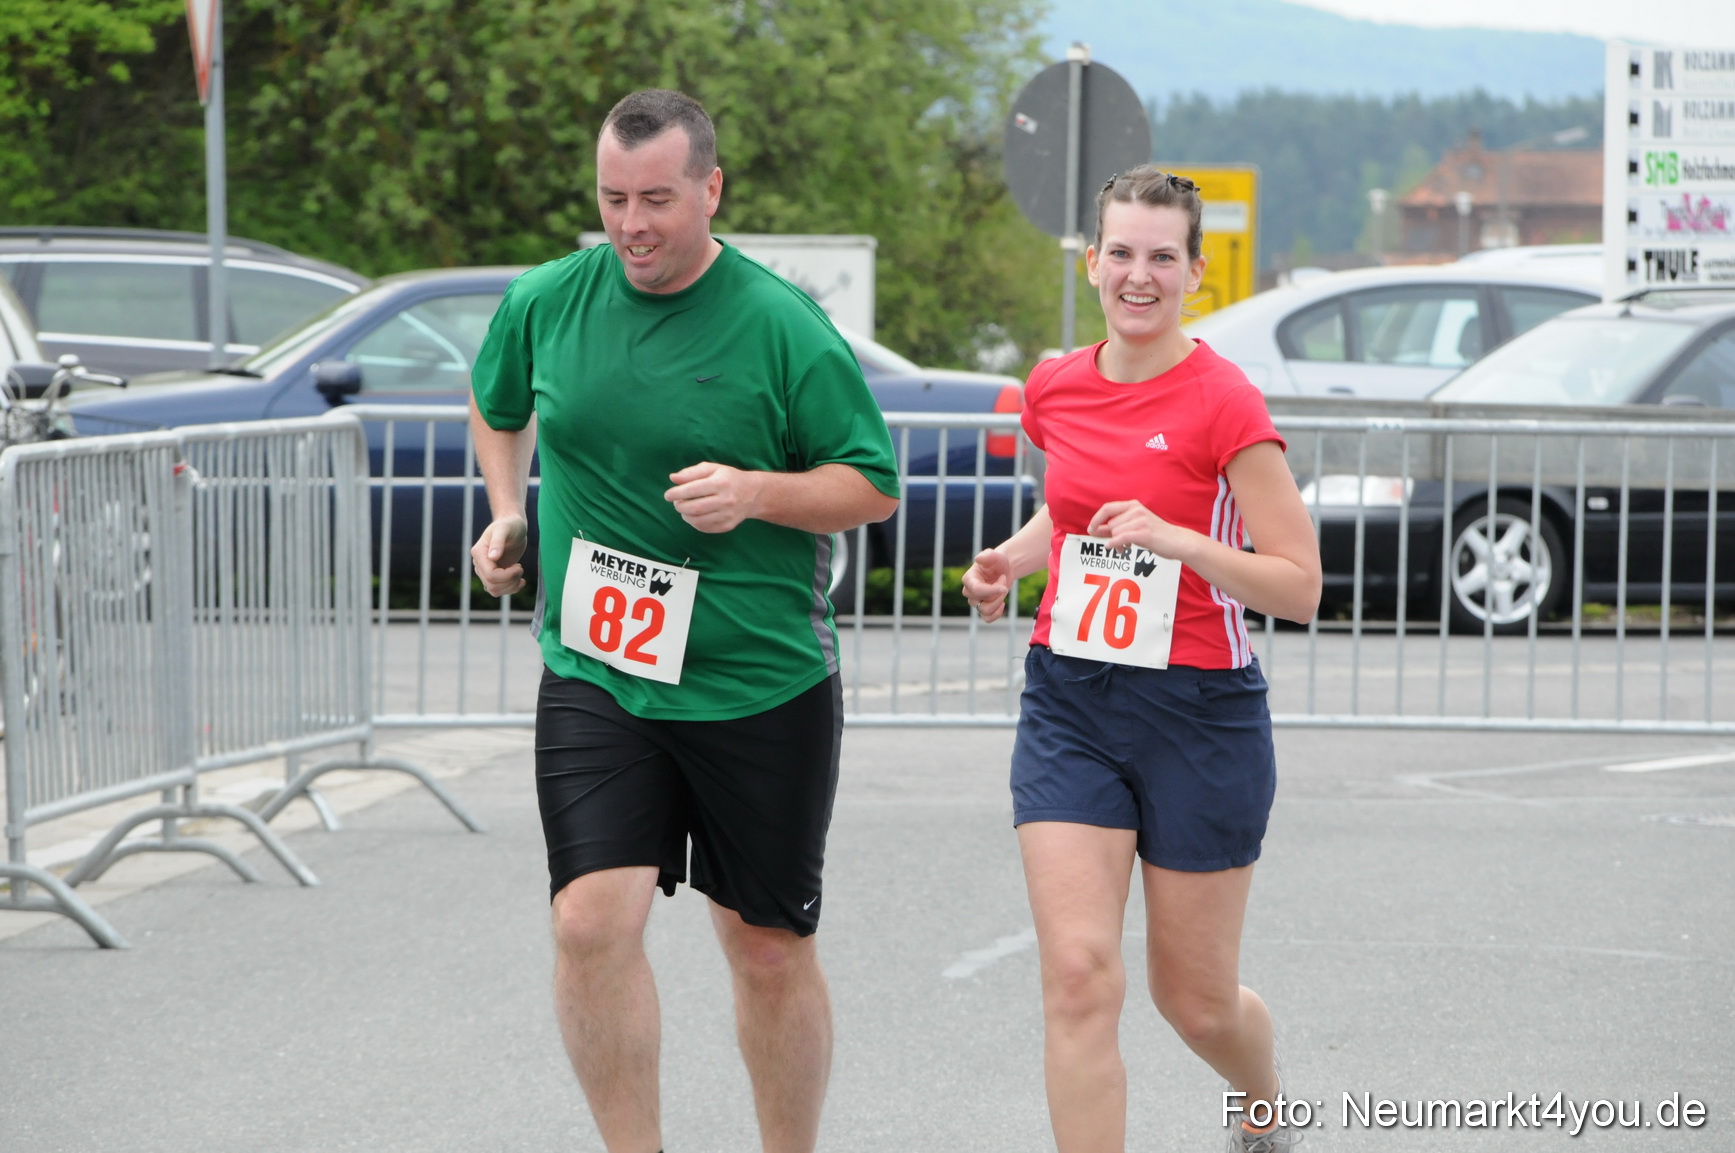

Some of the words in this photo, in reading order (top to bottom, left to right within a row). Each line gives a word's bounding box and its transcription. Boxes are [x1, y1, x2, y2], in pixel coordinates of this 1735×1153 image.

[1645, 152, 1679, 184] SHB
[1644, 250, 1699, 281] THULE
[1145, 441, 1168, 450] adidas
[590, 563, 646, 588] WERBUNG
[591, 550, 647, 578] MEYER
[1080, 556, 1131, 572] WERBUNG
[589, 586, 665, 666] 82
[1077, 573, 1141, 650] 76
